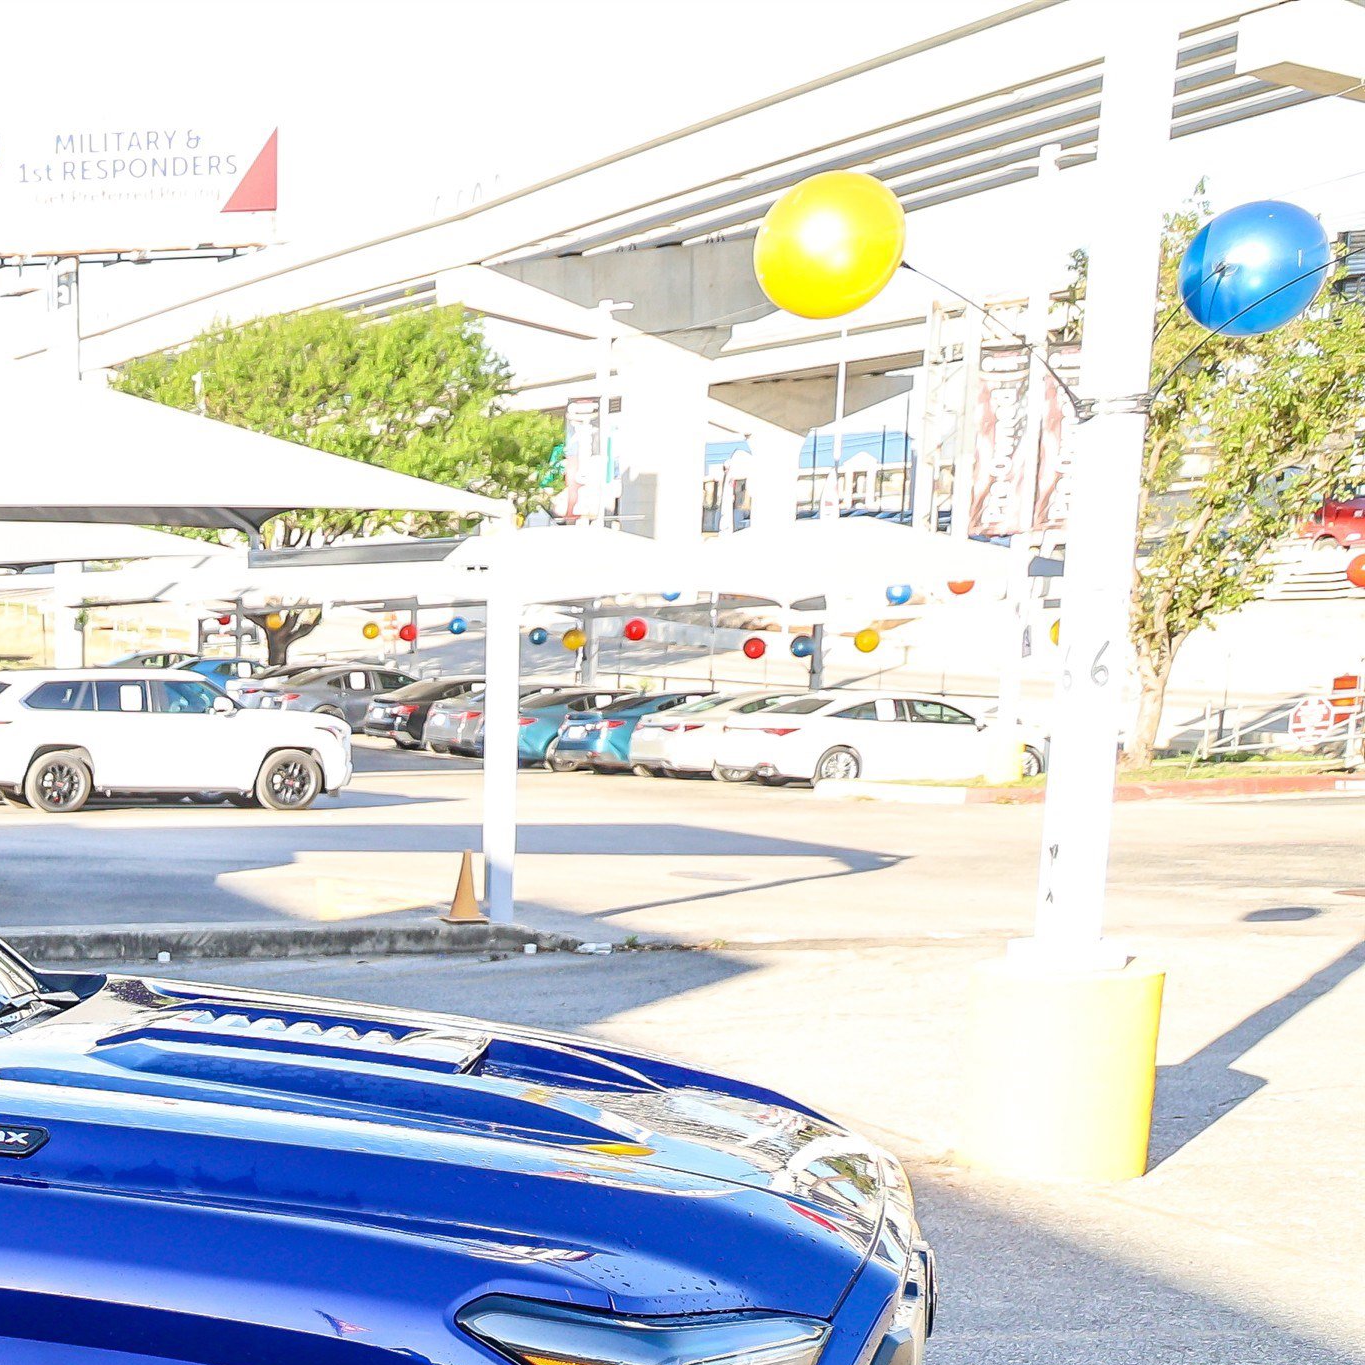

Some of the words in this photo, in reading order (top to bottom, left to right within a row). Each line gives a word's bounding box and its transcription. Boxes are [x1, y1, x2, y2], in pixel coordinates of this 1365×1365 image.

[56, 130, 176, 154] MILITARY
[186, 129, 202, 149] &
[19, 163, 53, 183] 1st
[63, 155, 238, 181] RESPONDERS
[1090, 640, 1110, 687] 6
